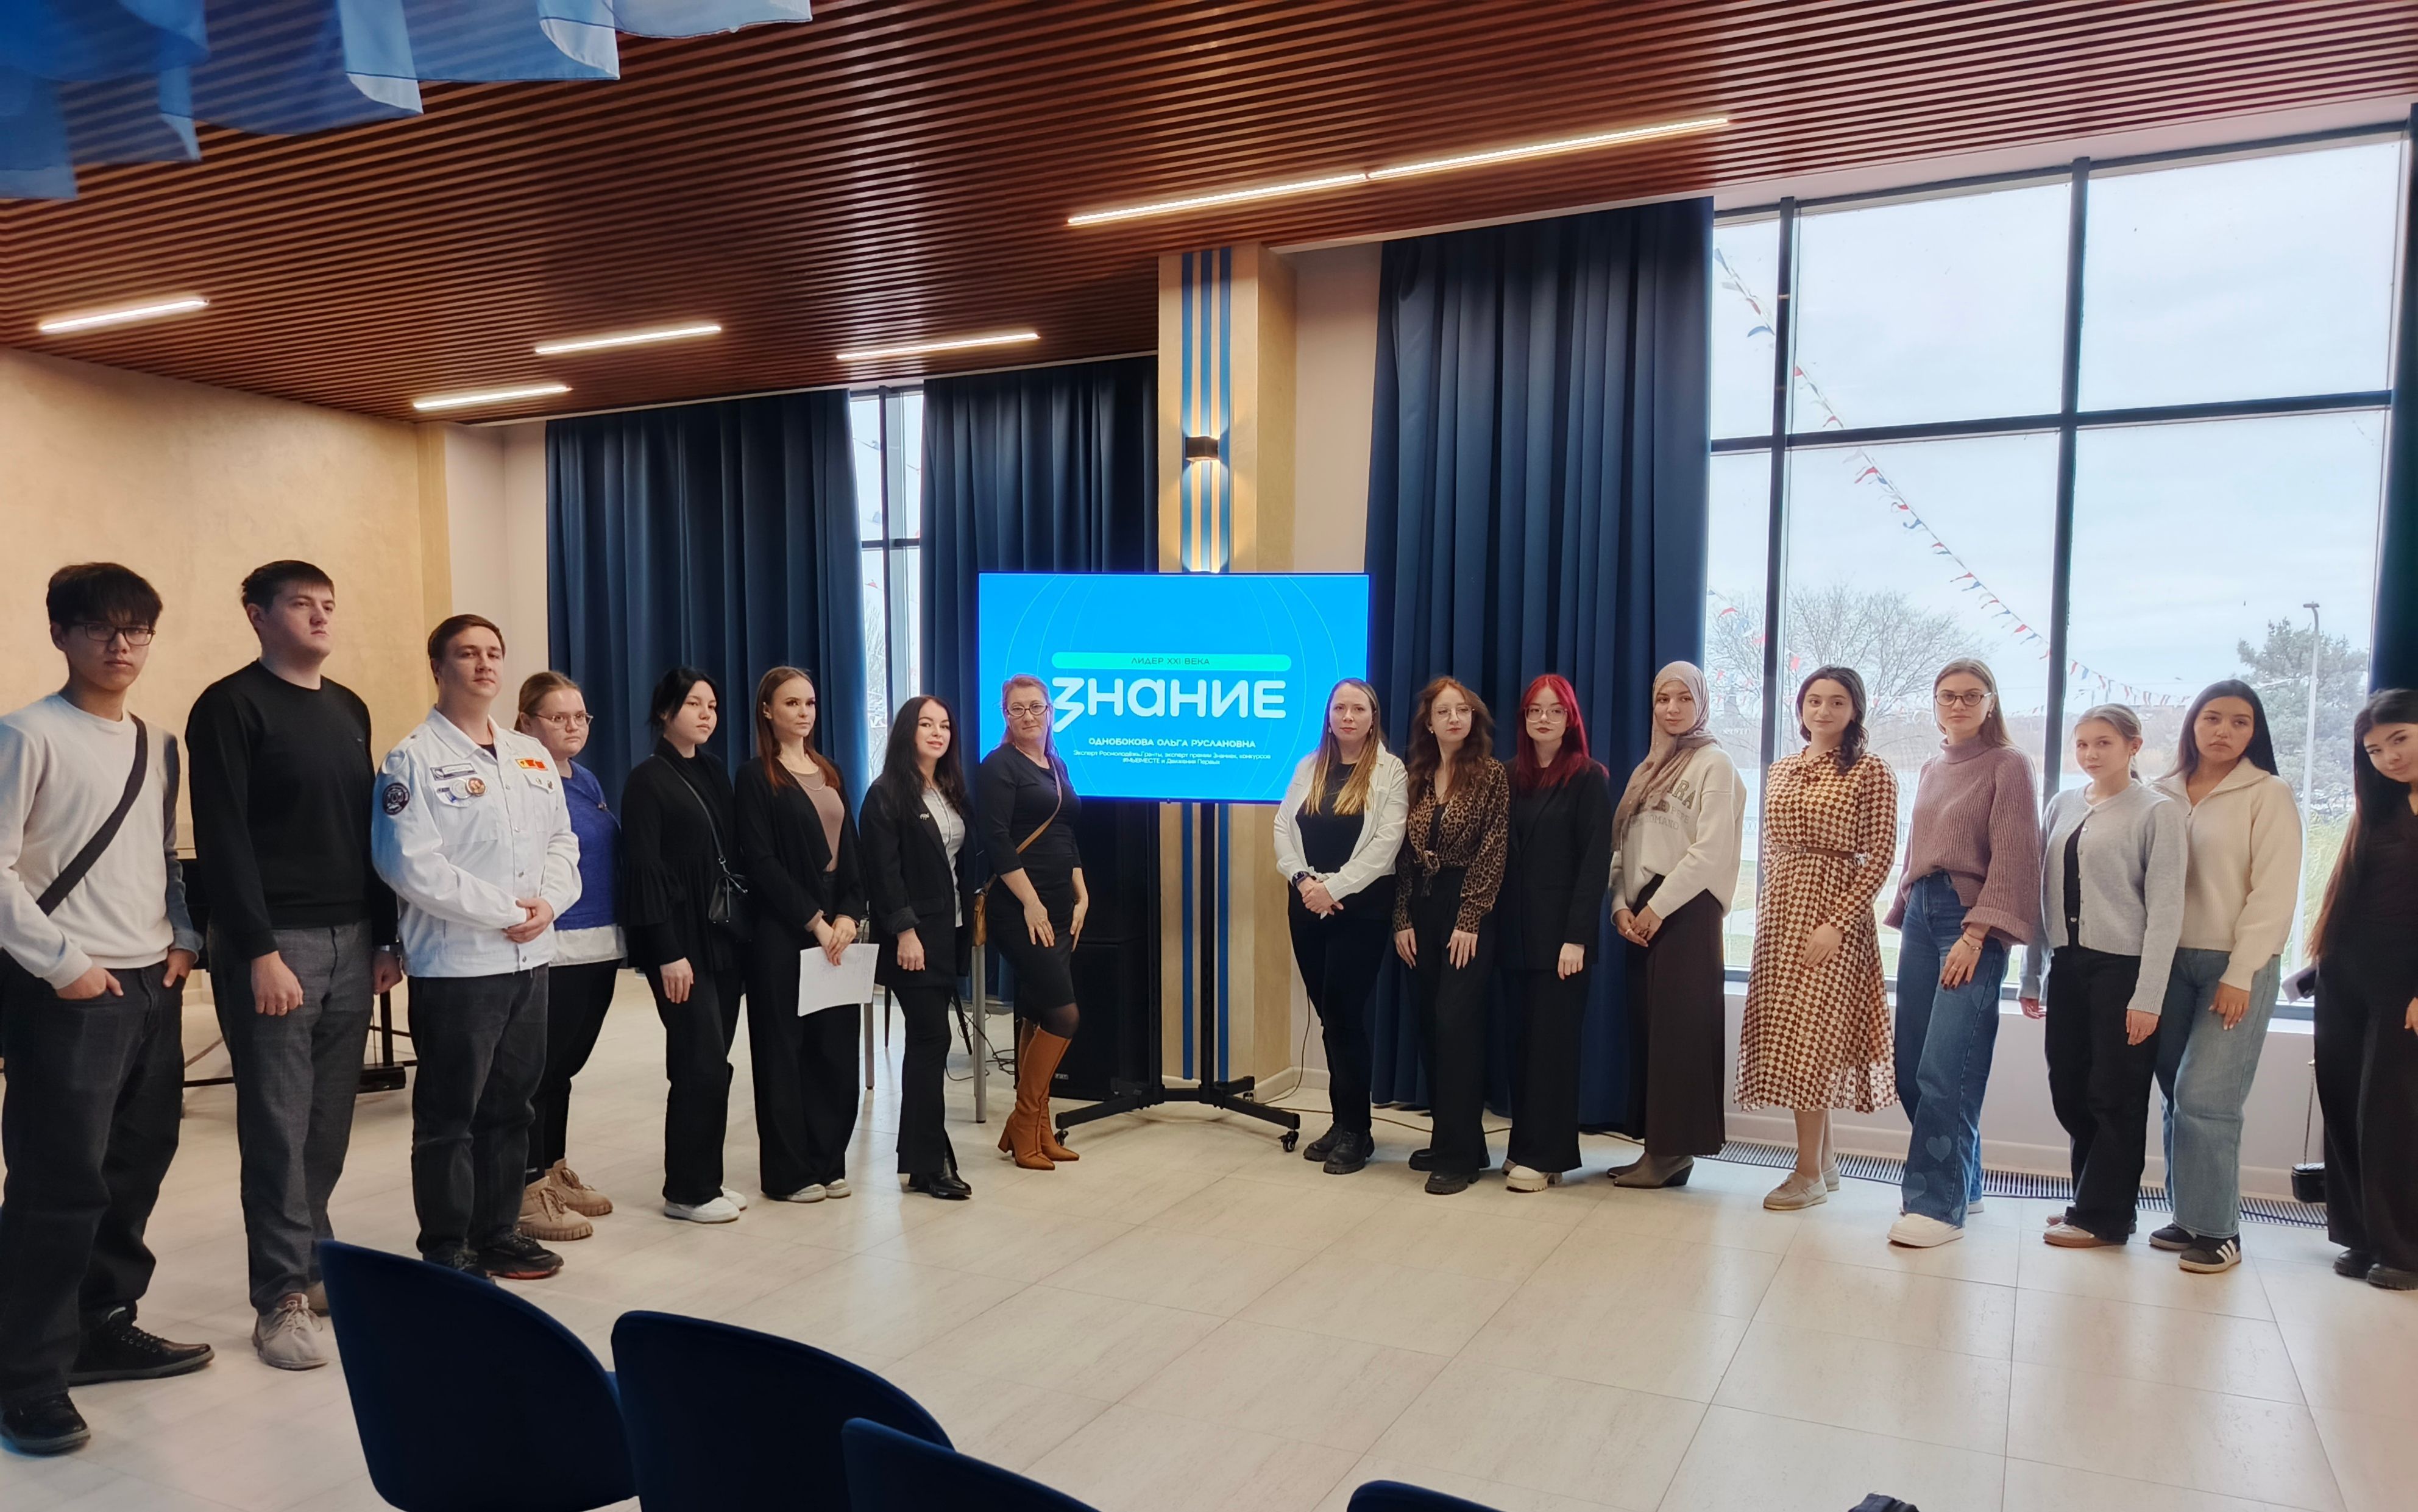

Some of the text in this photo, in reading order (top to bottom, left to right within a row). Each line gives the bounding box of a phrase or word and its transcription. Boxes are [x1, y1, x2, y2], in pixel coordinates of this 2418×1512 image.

[1132, 657, 1164, 665] ЛИДЕР
[1088, 738, 1257, 748] ОДНОБОКОВА ОЛЬГА РУСЛАНОВНА
